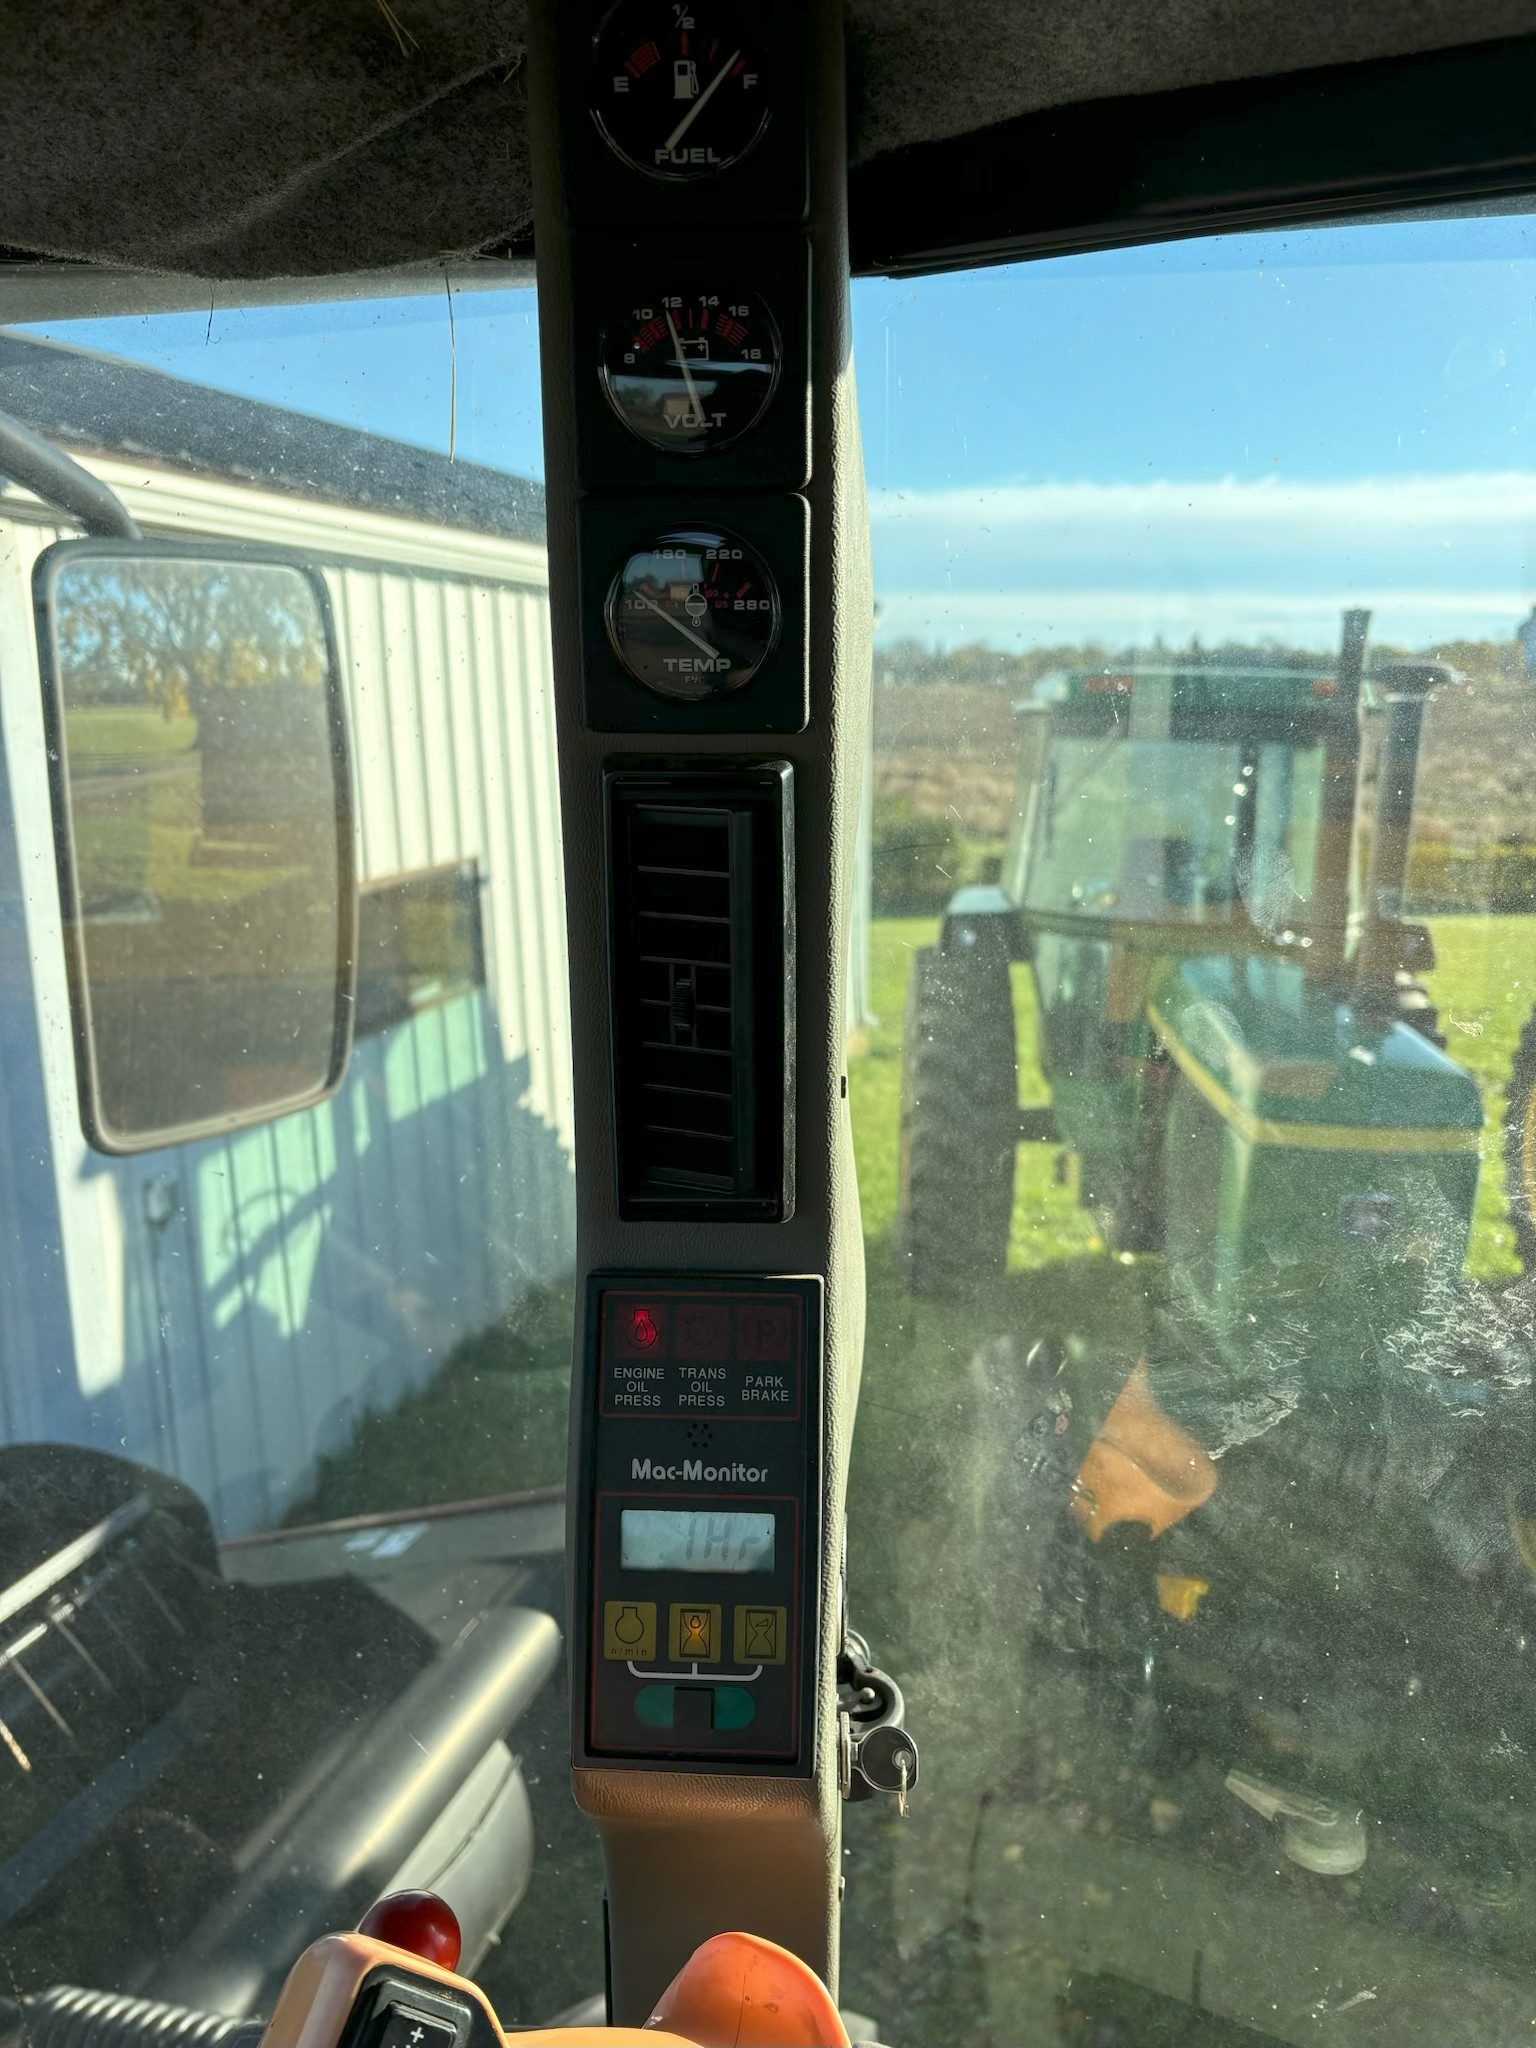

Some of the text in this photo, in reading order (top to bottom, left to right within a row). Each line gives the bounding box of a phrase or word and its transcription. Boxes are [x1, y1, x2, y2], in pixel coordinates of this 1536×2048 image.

[613, 76, 630, 92] E
[743, 74, 758, 89] F
[655, 147, 720, 164] FUEL
[662, 296, 682, 308] 12
[699, 296, 720, 307] 14
[632, 308, 653, 320] 10
[728, 305, 750, 317] 16
[623, 353, 635, 364] 8
[741, 349, 762, 360] 18
[652, 549, 687, 560] 180
[705, 549, 743, 560] 220
[733, 600, 771, 611] 280
[663, 658, 732, 673] TEMP
[613, 1367, 665, 1380] ENGINE
[678, 1367, 727, 1380] TRANS
[626, 1381, 649, 1393] OIL
[690, 1381, 713, 1393] OIL
[745, 1376, 784, 1388] PARK
[614, 1395, 662, 1407] PRESS
[678, 1395, 726, 1407] PRESS
[741, 1389, 789, 1402] BRAKE
[631, 1457, 768, 1483] Mac-Monitor
